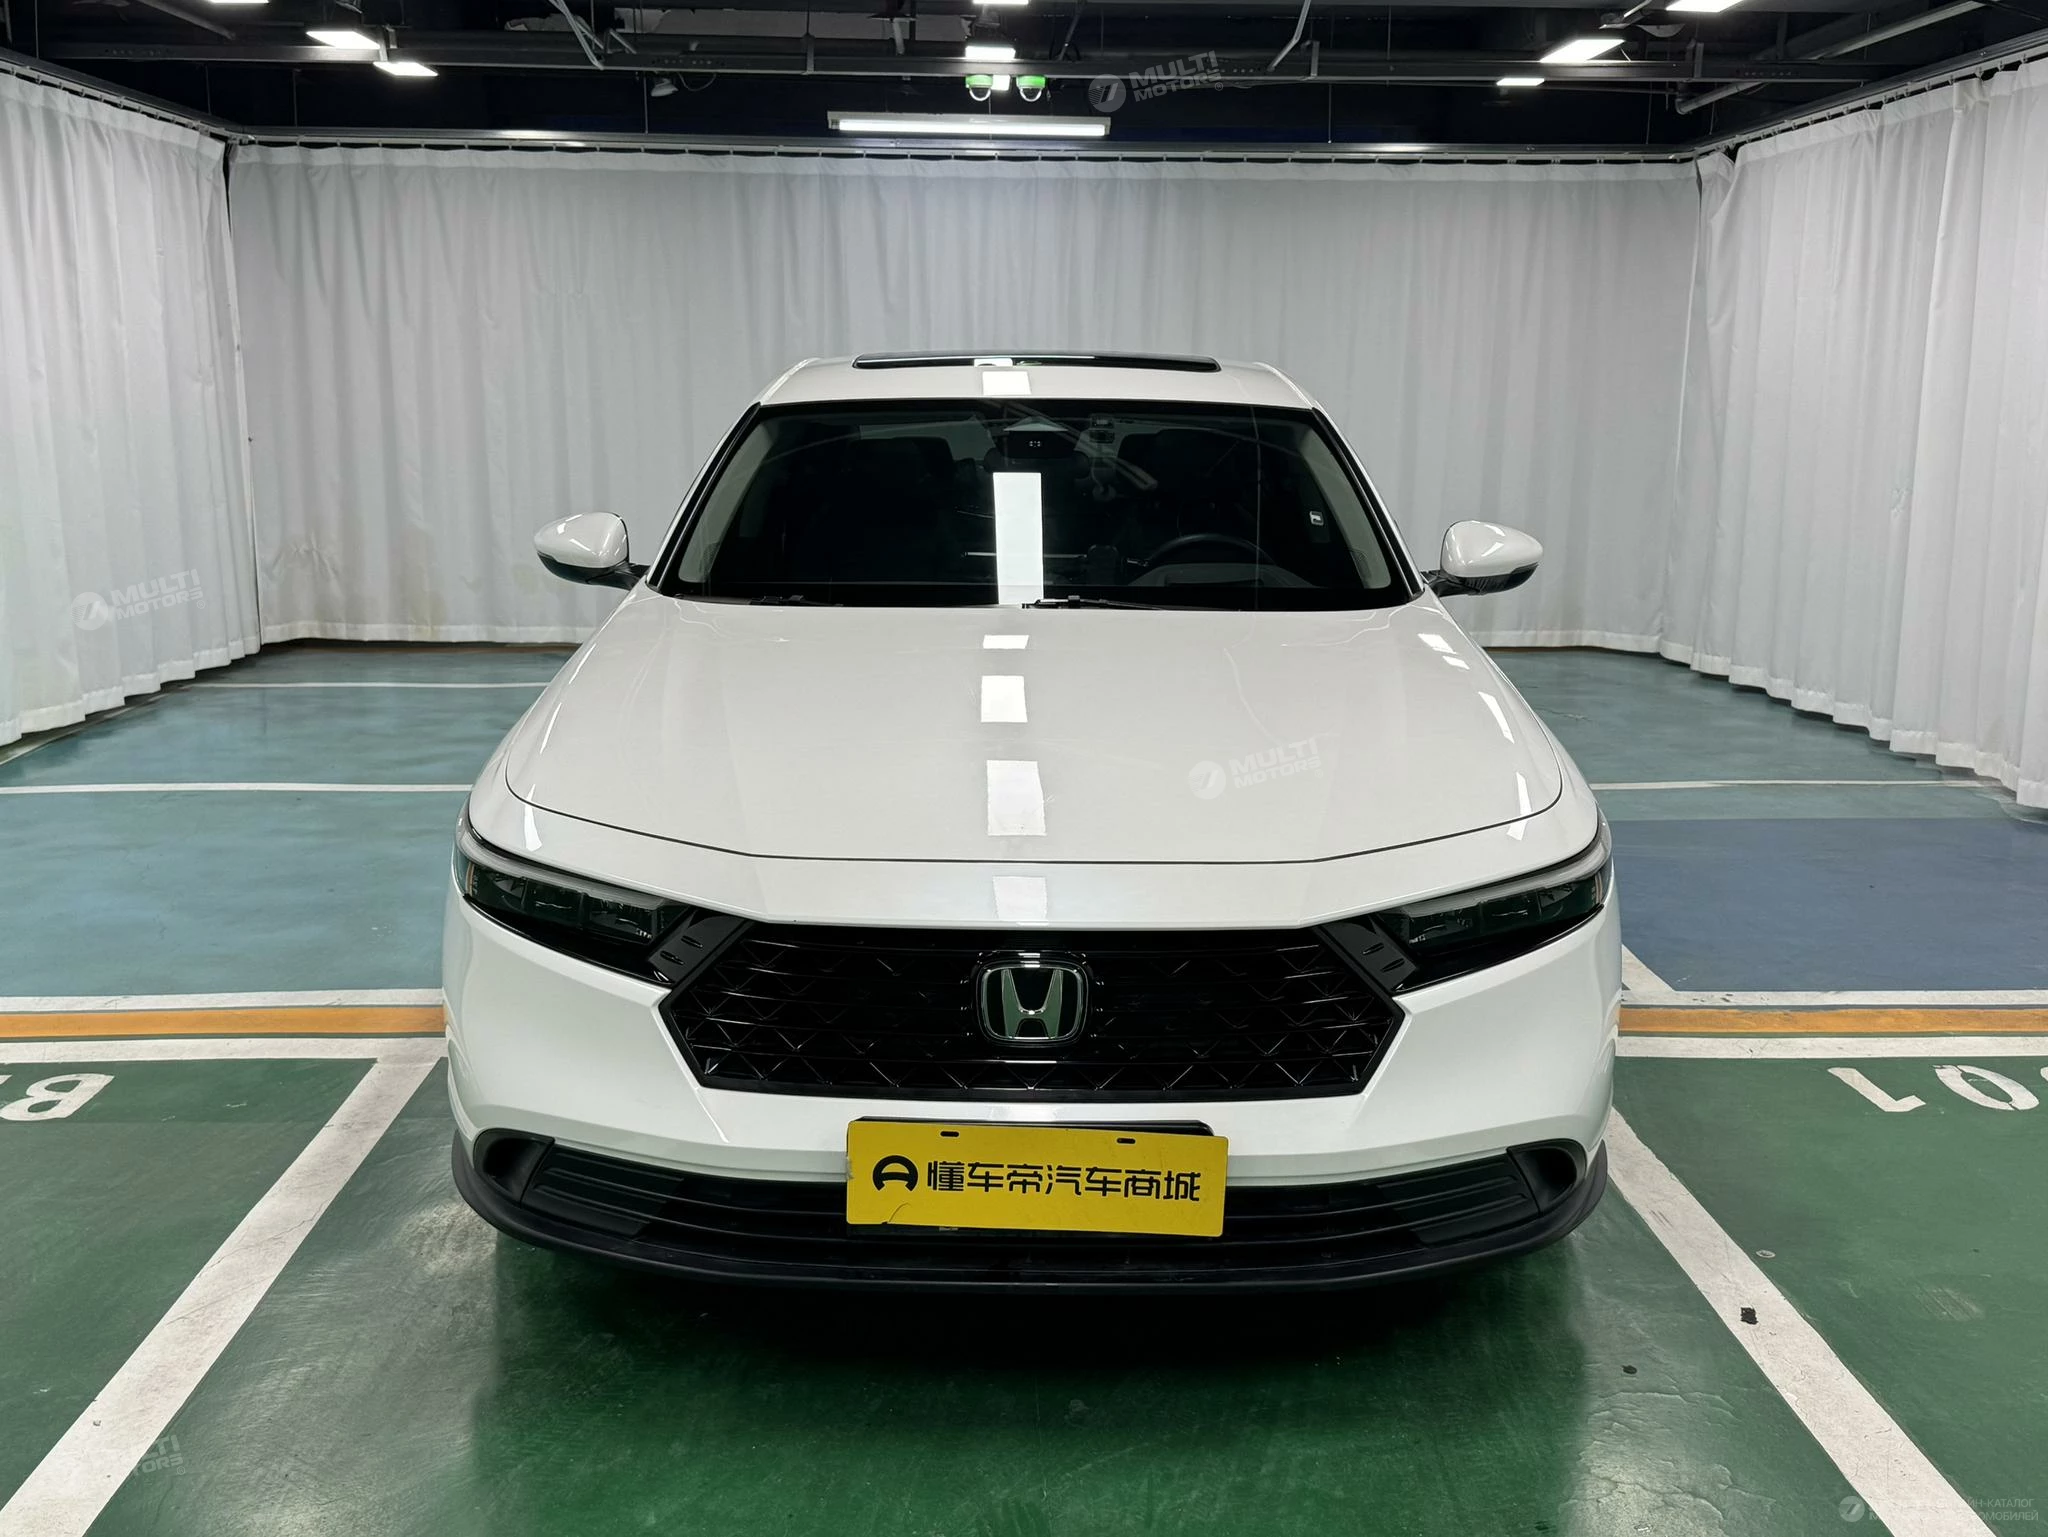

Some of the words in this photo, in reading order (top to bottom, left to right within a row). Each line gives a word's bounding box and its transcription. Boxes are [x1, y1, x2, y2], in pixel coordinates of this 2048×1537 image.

[0, 1073, 115, 1121] B
[1827, 1064, 2048, 1112] 01
[927, 1160, 1202, 1201] 懂车帝汽车商城
